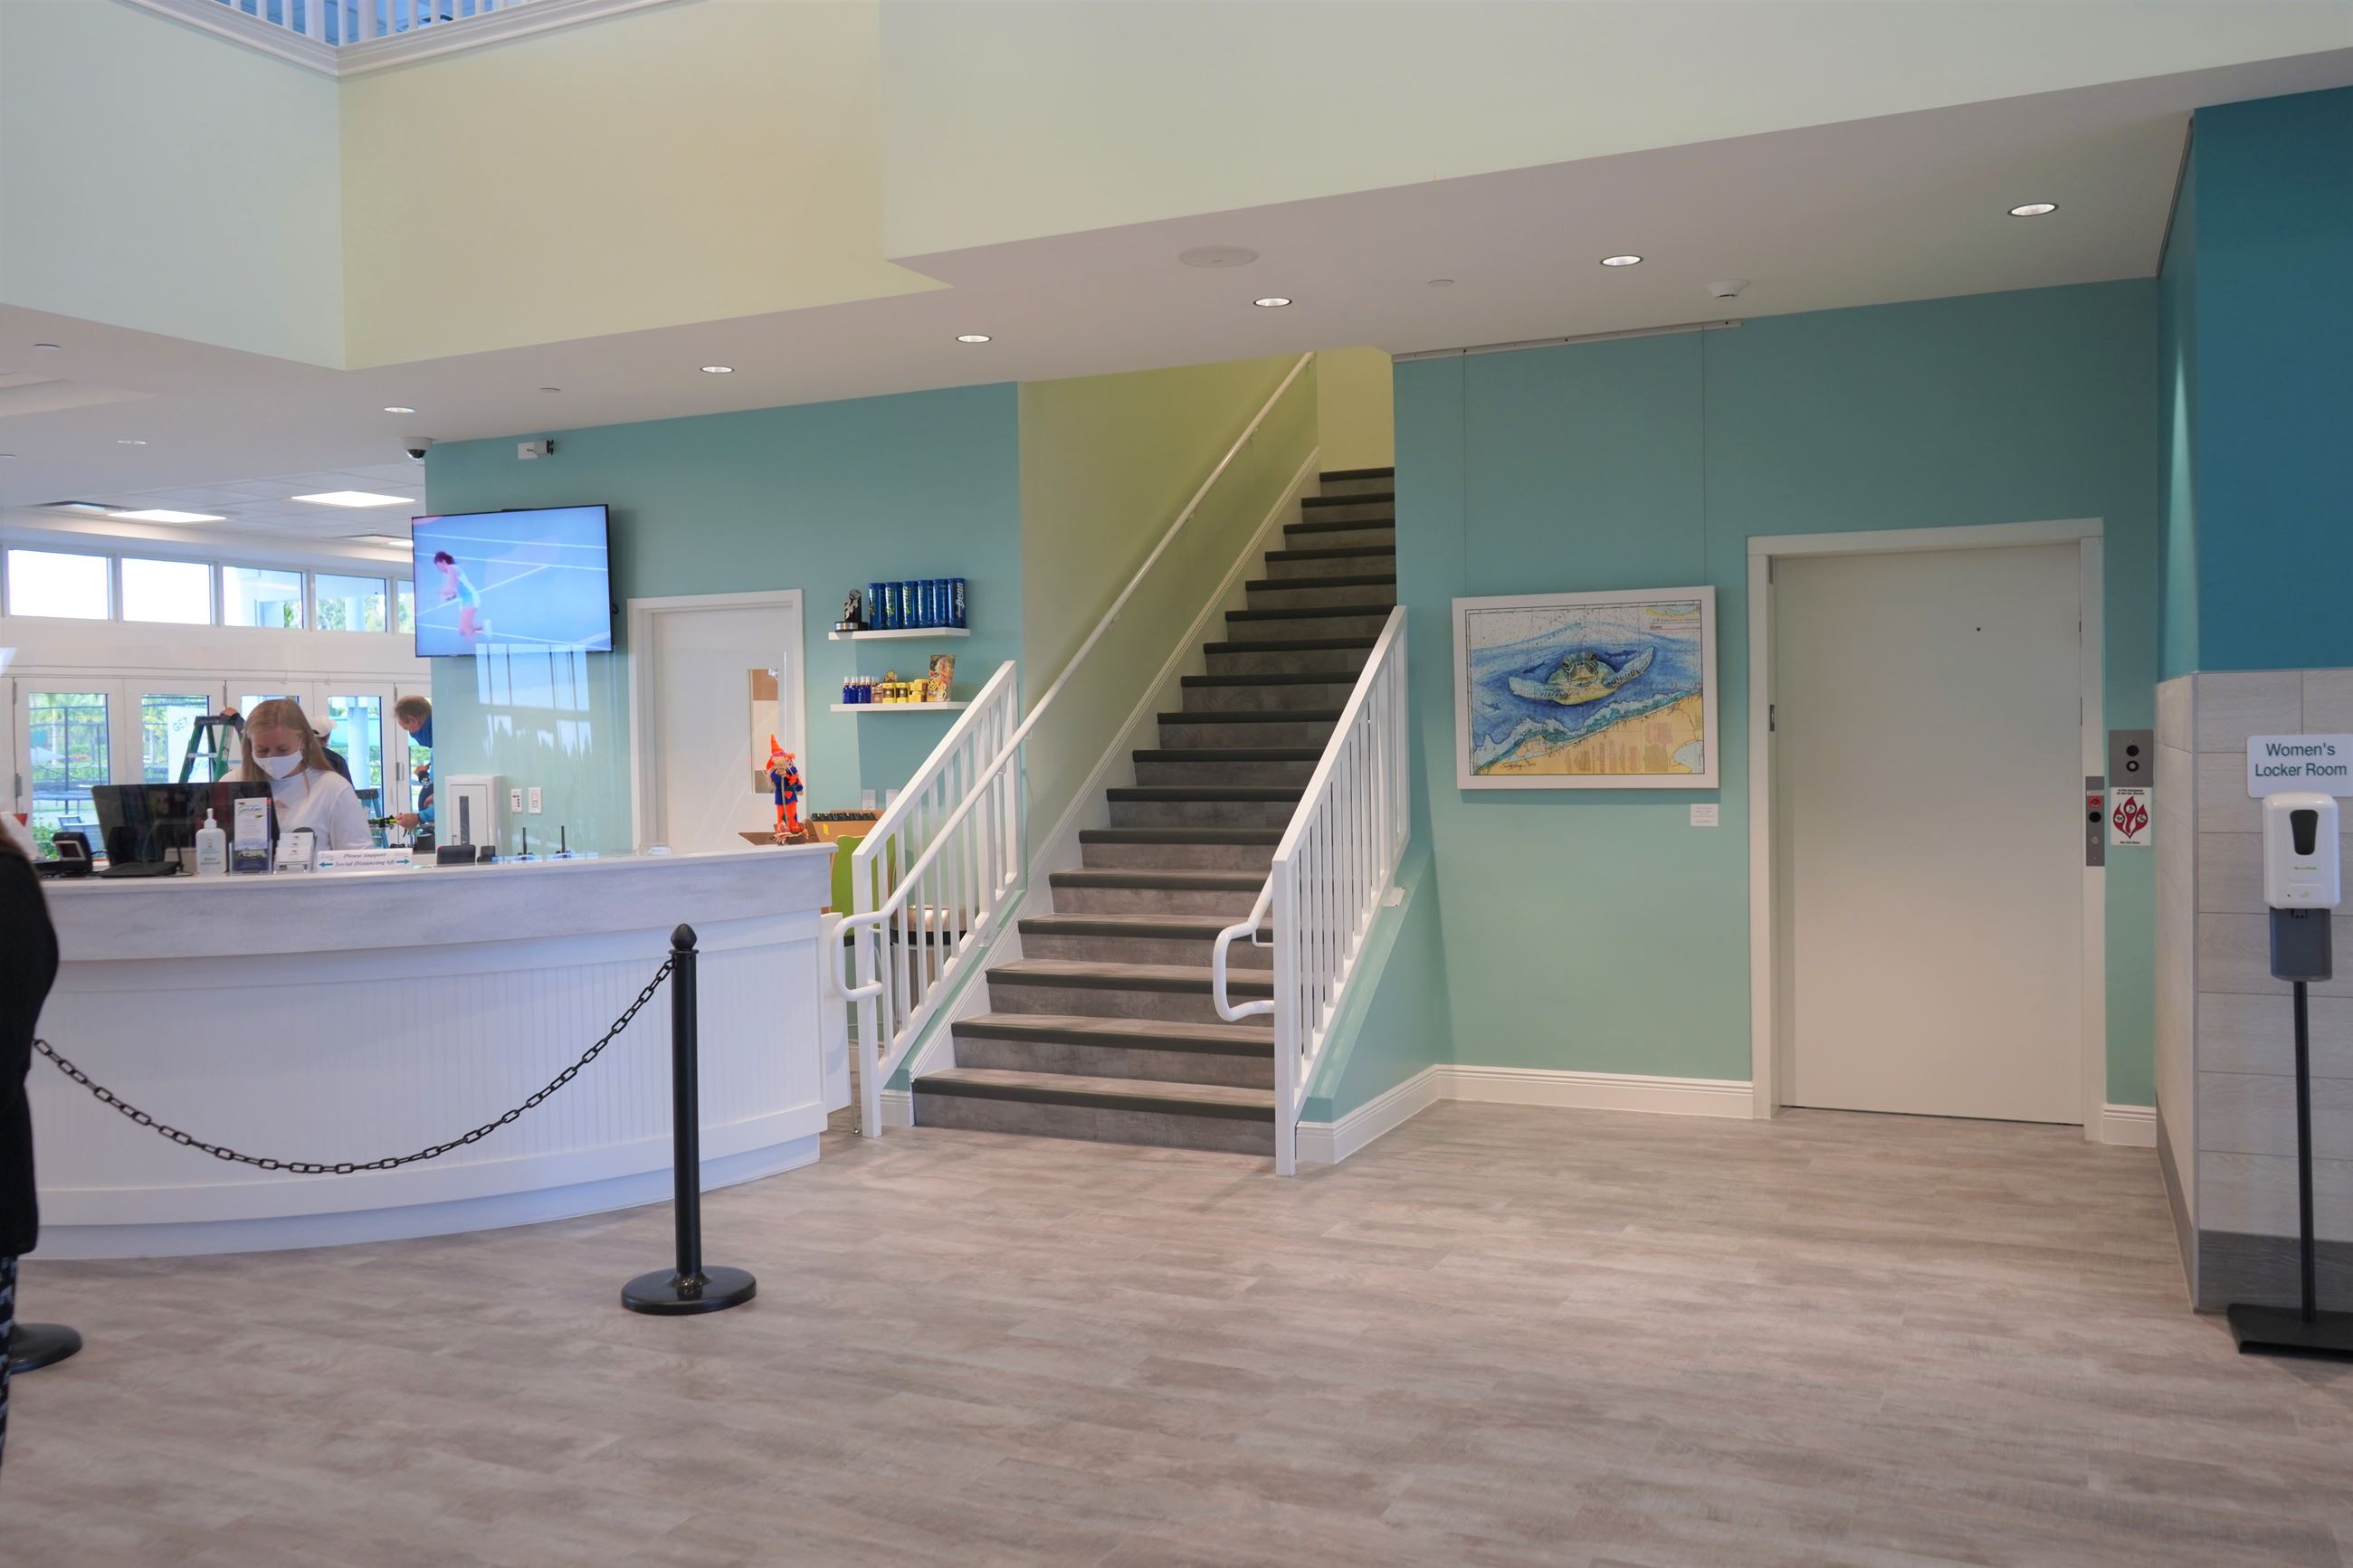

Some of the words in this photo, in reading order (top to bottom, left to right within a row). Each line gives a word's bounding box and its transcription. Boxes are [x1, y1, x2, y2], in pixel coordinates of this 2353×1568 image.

[2265, 742, 2336, 756] Women's
[2254, 763, 2302, 776] Locker
[2306, 763, 2348, 776] Room
